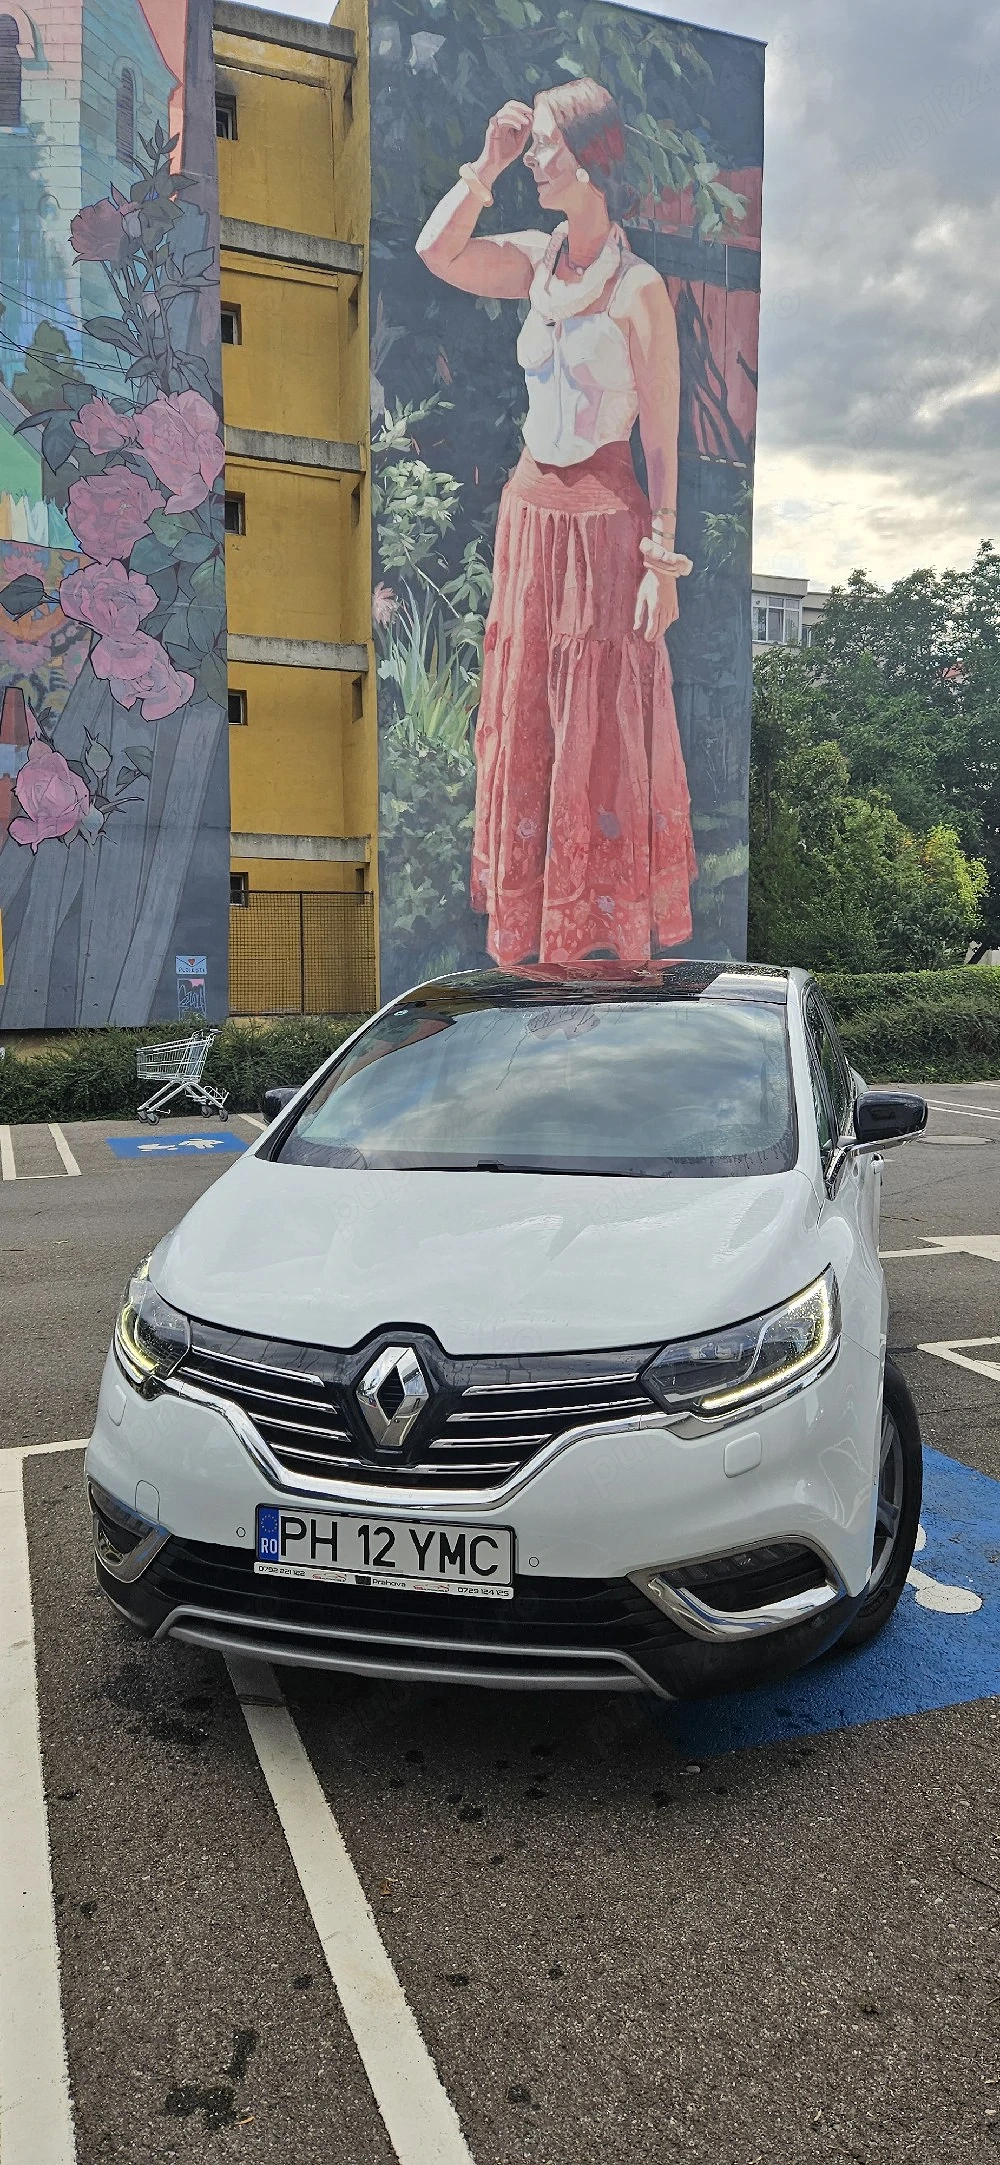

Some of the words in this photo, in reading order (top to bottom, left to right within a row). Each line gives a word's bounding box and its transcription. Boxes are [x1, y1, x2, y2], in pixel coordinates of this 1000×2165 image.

[260, 1537, 278, 1555] RO
[280, 1515, 338, 1562] PH
[357, 1524, 396, 1567] 12
[409, 1528, 499, 1577] YMC
[372, 1578, 406, 1588] Prahova
